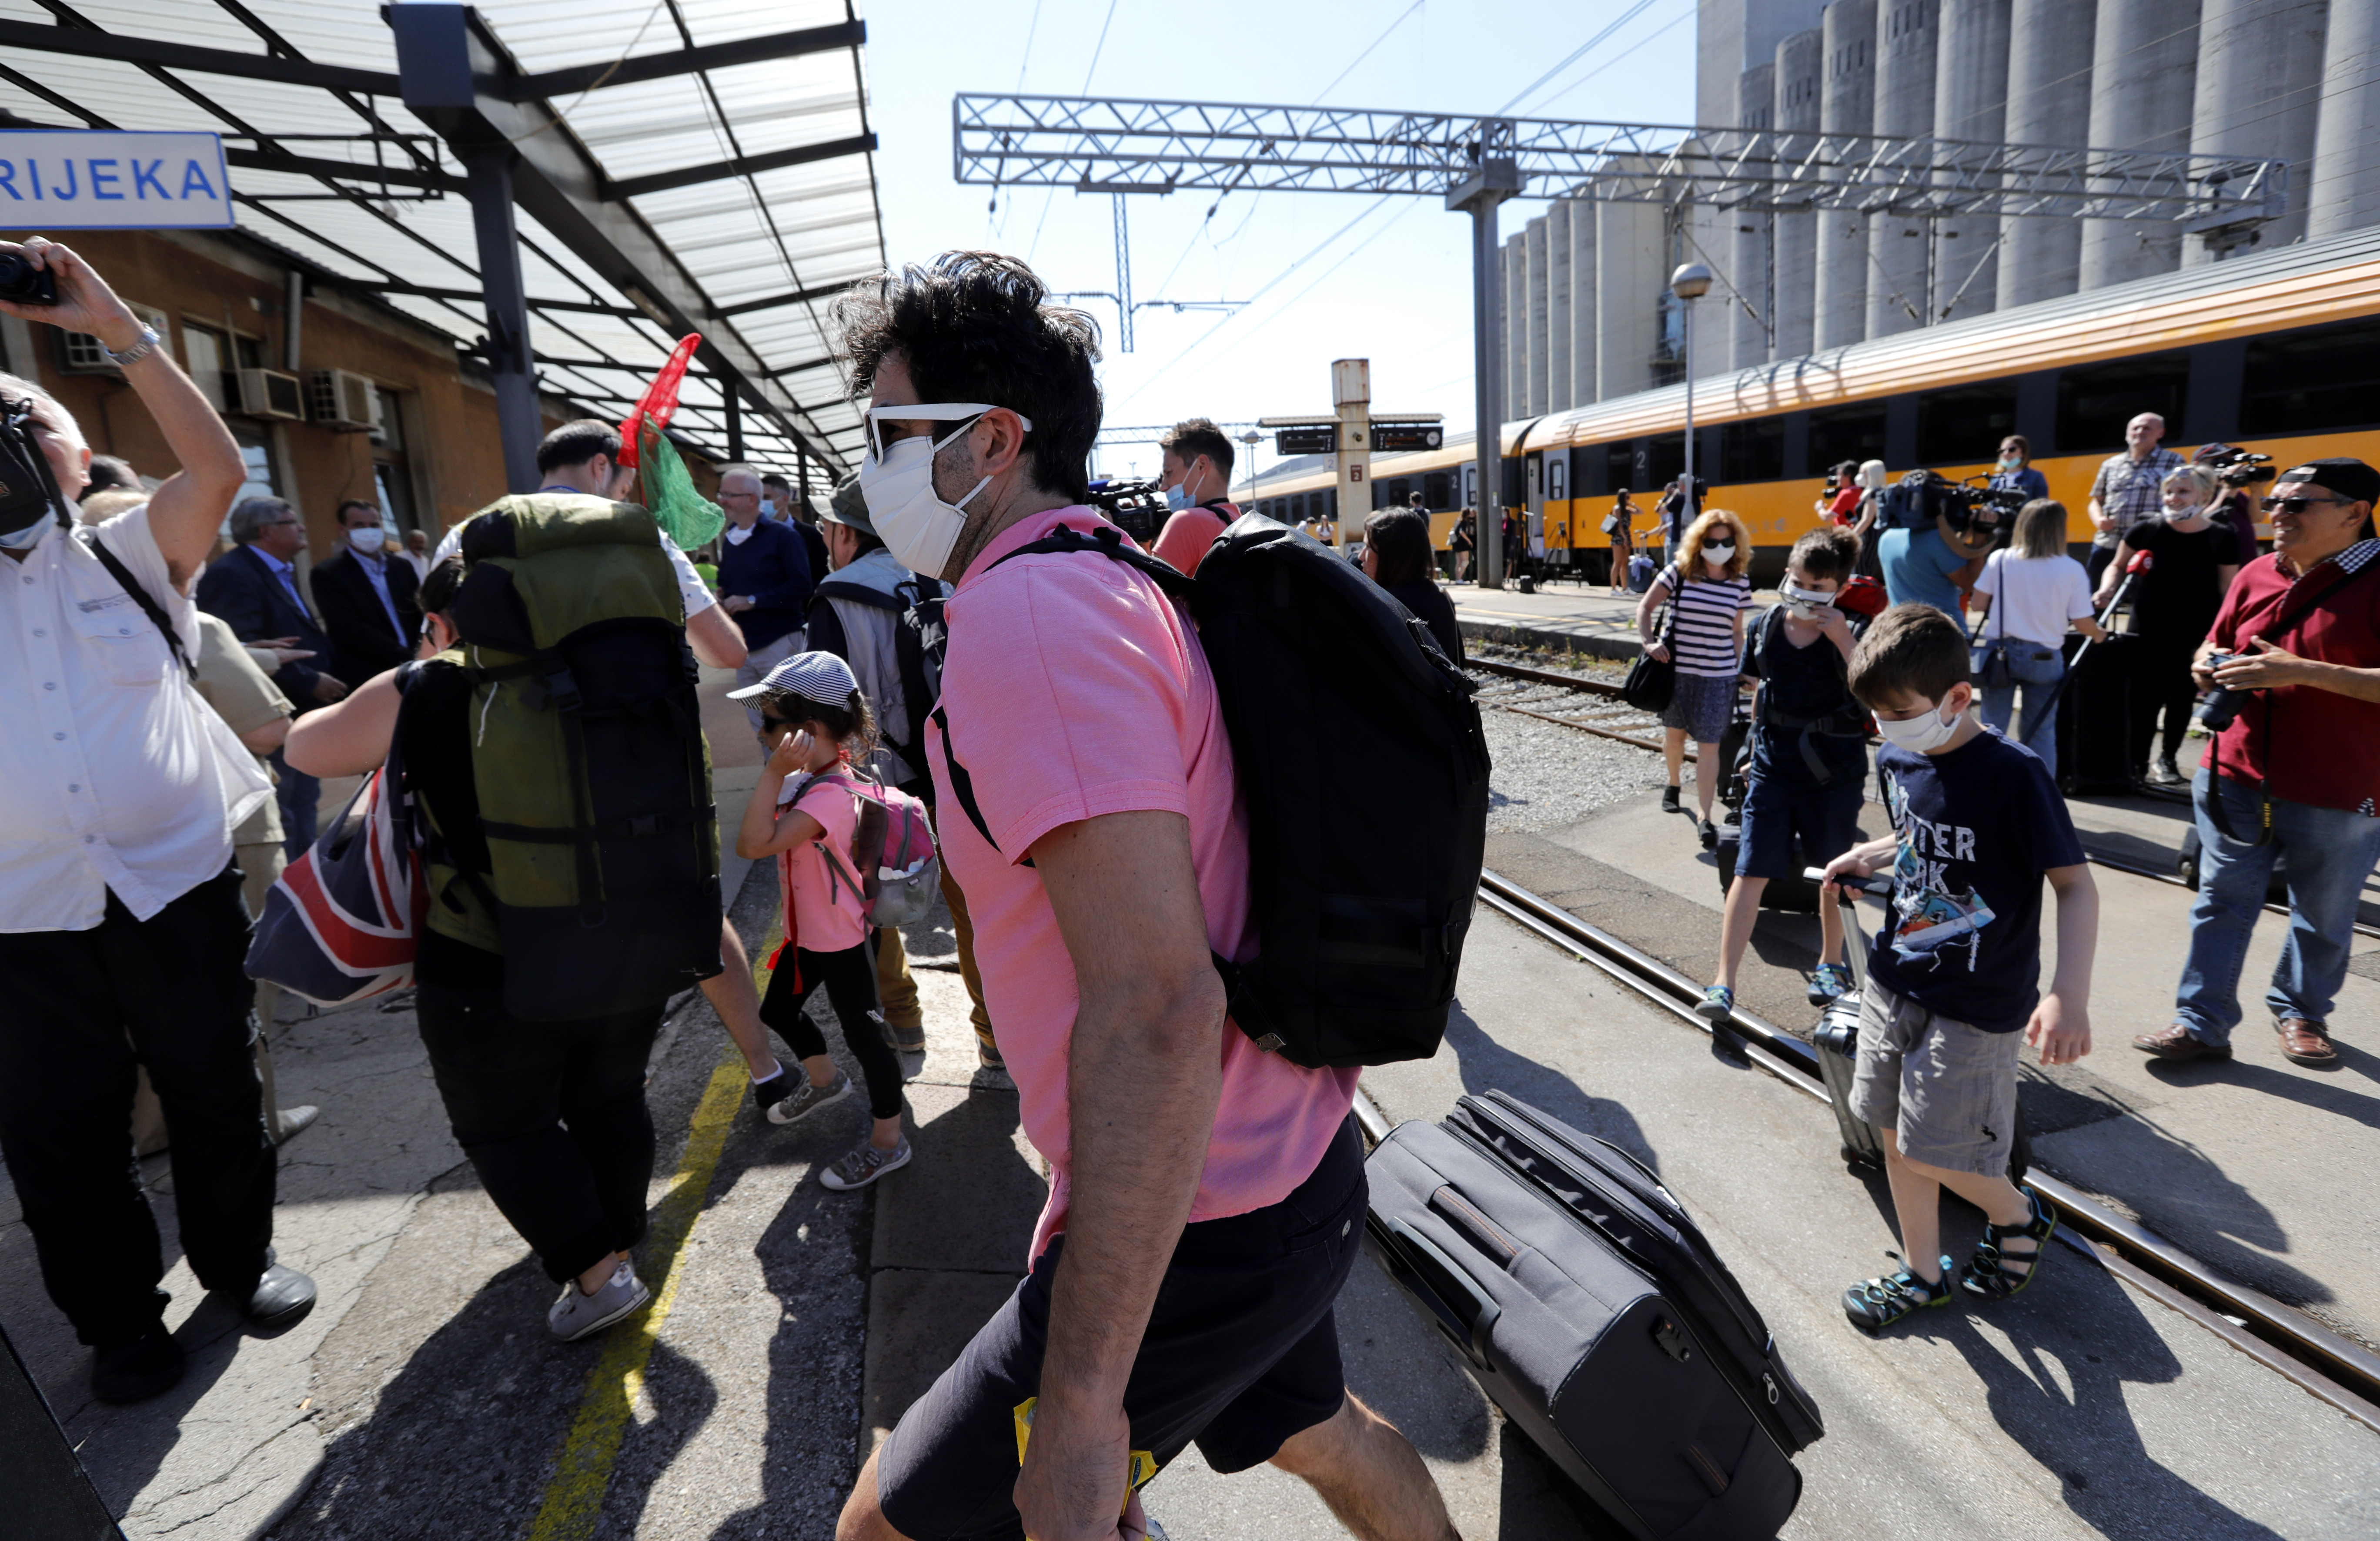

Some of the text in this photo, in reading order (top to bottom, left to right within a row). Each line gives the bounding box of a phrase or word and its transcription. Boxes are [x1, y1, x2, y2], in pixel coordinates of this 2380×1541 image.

[0, 159, 217, 200] RIJEKA
[1327, 459, 1334, 469] 2
[1637, 451, 1645, 469] 2
[1452, 475, 1457, 489] 2
